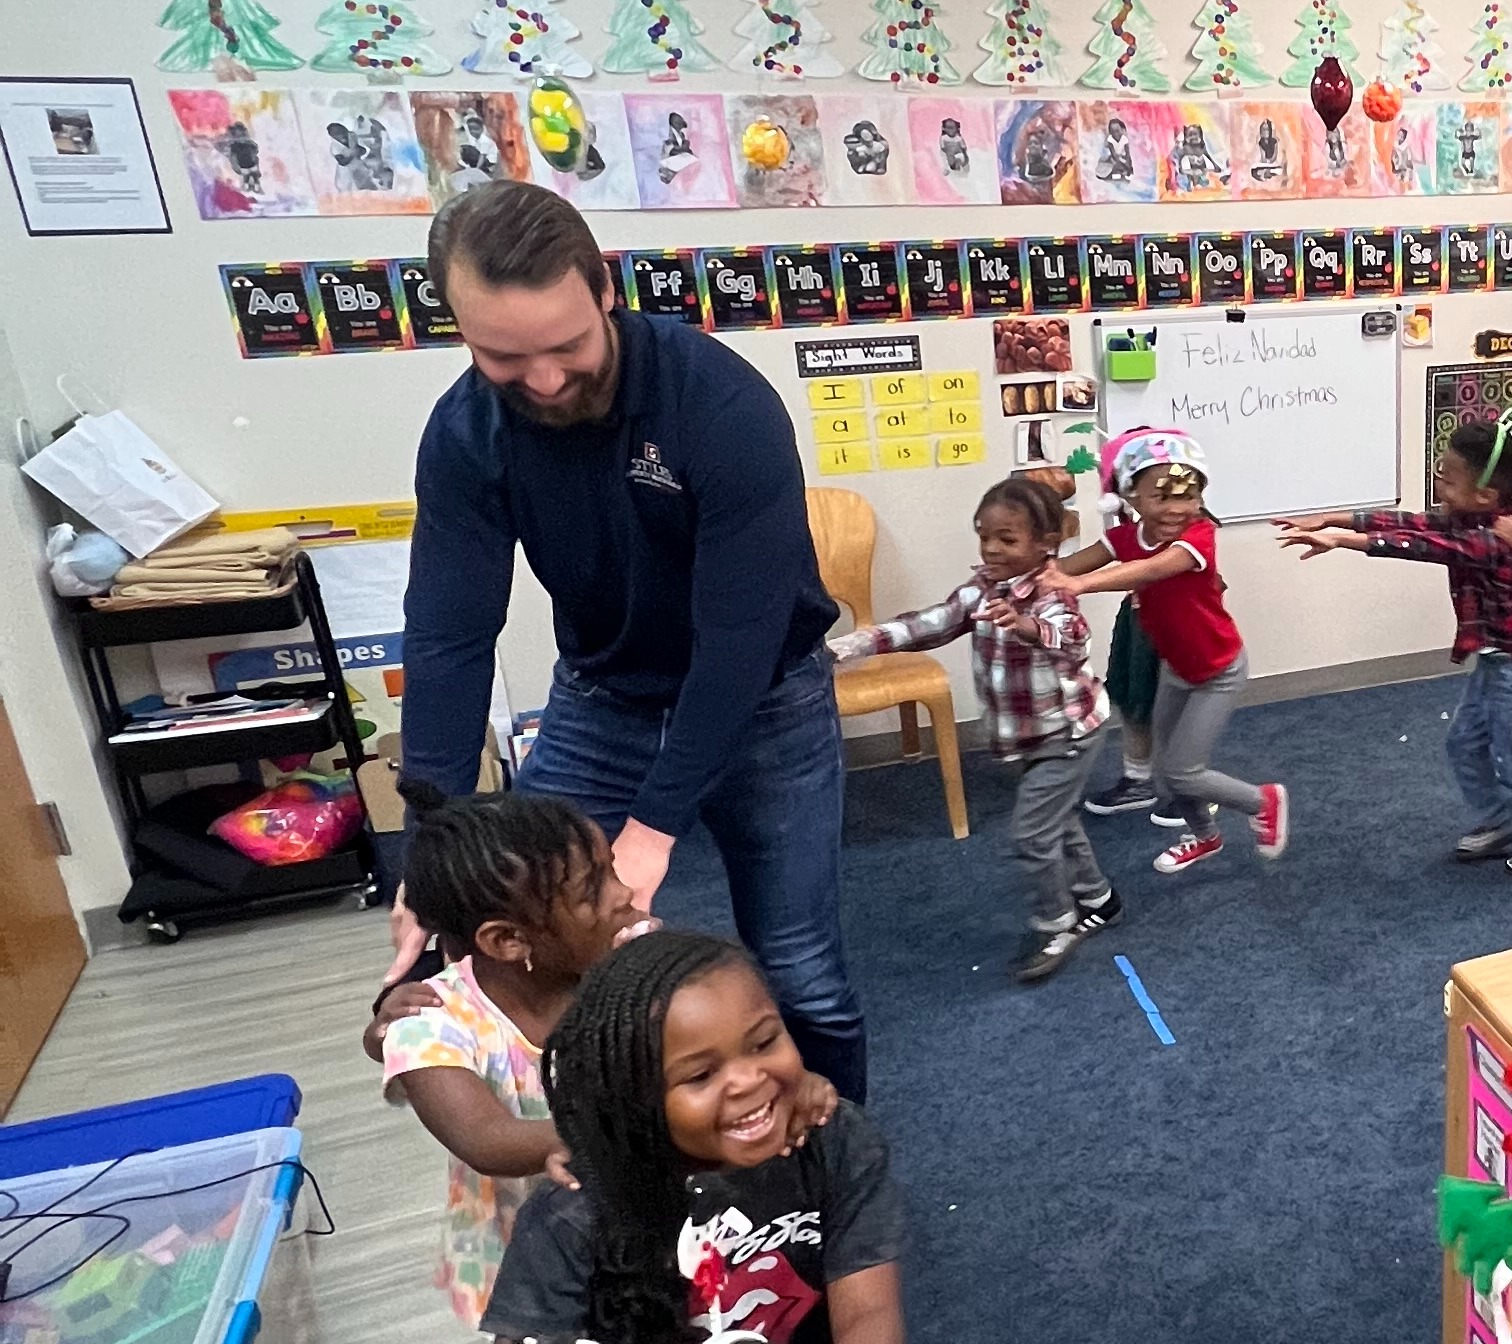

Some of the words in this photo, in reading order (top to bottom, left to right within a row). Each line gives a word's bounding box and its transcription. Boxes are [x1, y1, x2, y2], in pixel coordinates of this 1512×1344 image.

[1205, 250, 1238, 273] Oo
[1260, 248, 1288, 276] Pp
[1309, 246, 1338, 274] Qq
[1361, 244, 1387, 267] Rr
[1409, 242, 1433, 265] Ss
[1457, 240, 1479, 262] Tt
[859, 262, 881, 287] Ii
[924, 259, 944, 292] Jj
[979, 257, 1011, 282] Kk
[1043, 255, 1066, 279] Ll
[1093, 253, 1132, 278] Mm
[1152, 252, 1184, 275] Nn
[650, 270, 683, 297] Ff
[716, 268, 757, 301] Gg
[786, 265, 823, 290] Hh
[248, 287, 300, 315] Aa
[334, 283, 381, 312] Bb
[417, 280, 441, 307] C
[812, 348, 848, 367] Sight
[862, 346, 904, 359] Words
[1182, 332, 1245, 368] Feliz
[1251, 327, 1317, 363] Navidad
[823, 383, 846, 401] I
[887, 378, 905, 394] of
[943, 377, 964, 390] on
[949, 407, 967, 425] to
[1171, 393, 1230, 425] Merry
[1240, 386, 1338, 418] Christmas
[832, 419, 849, 433] a
[887, 410, 906, 427] at
[834, 448, 849, 465] it
[897, 446, 911, 459] is
[952, 442, 969, 459] go
[273, 643, 386, 671] Shpes
